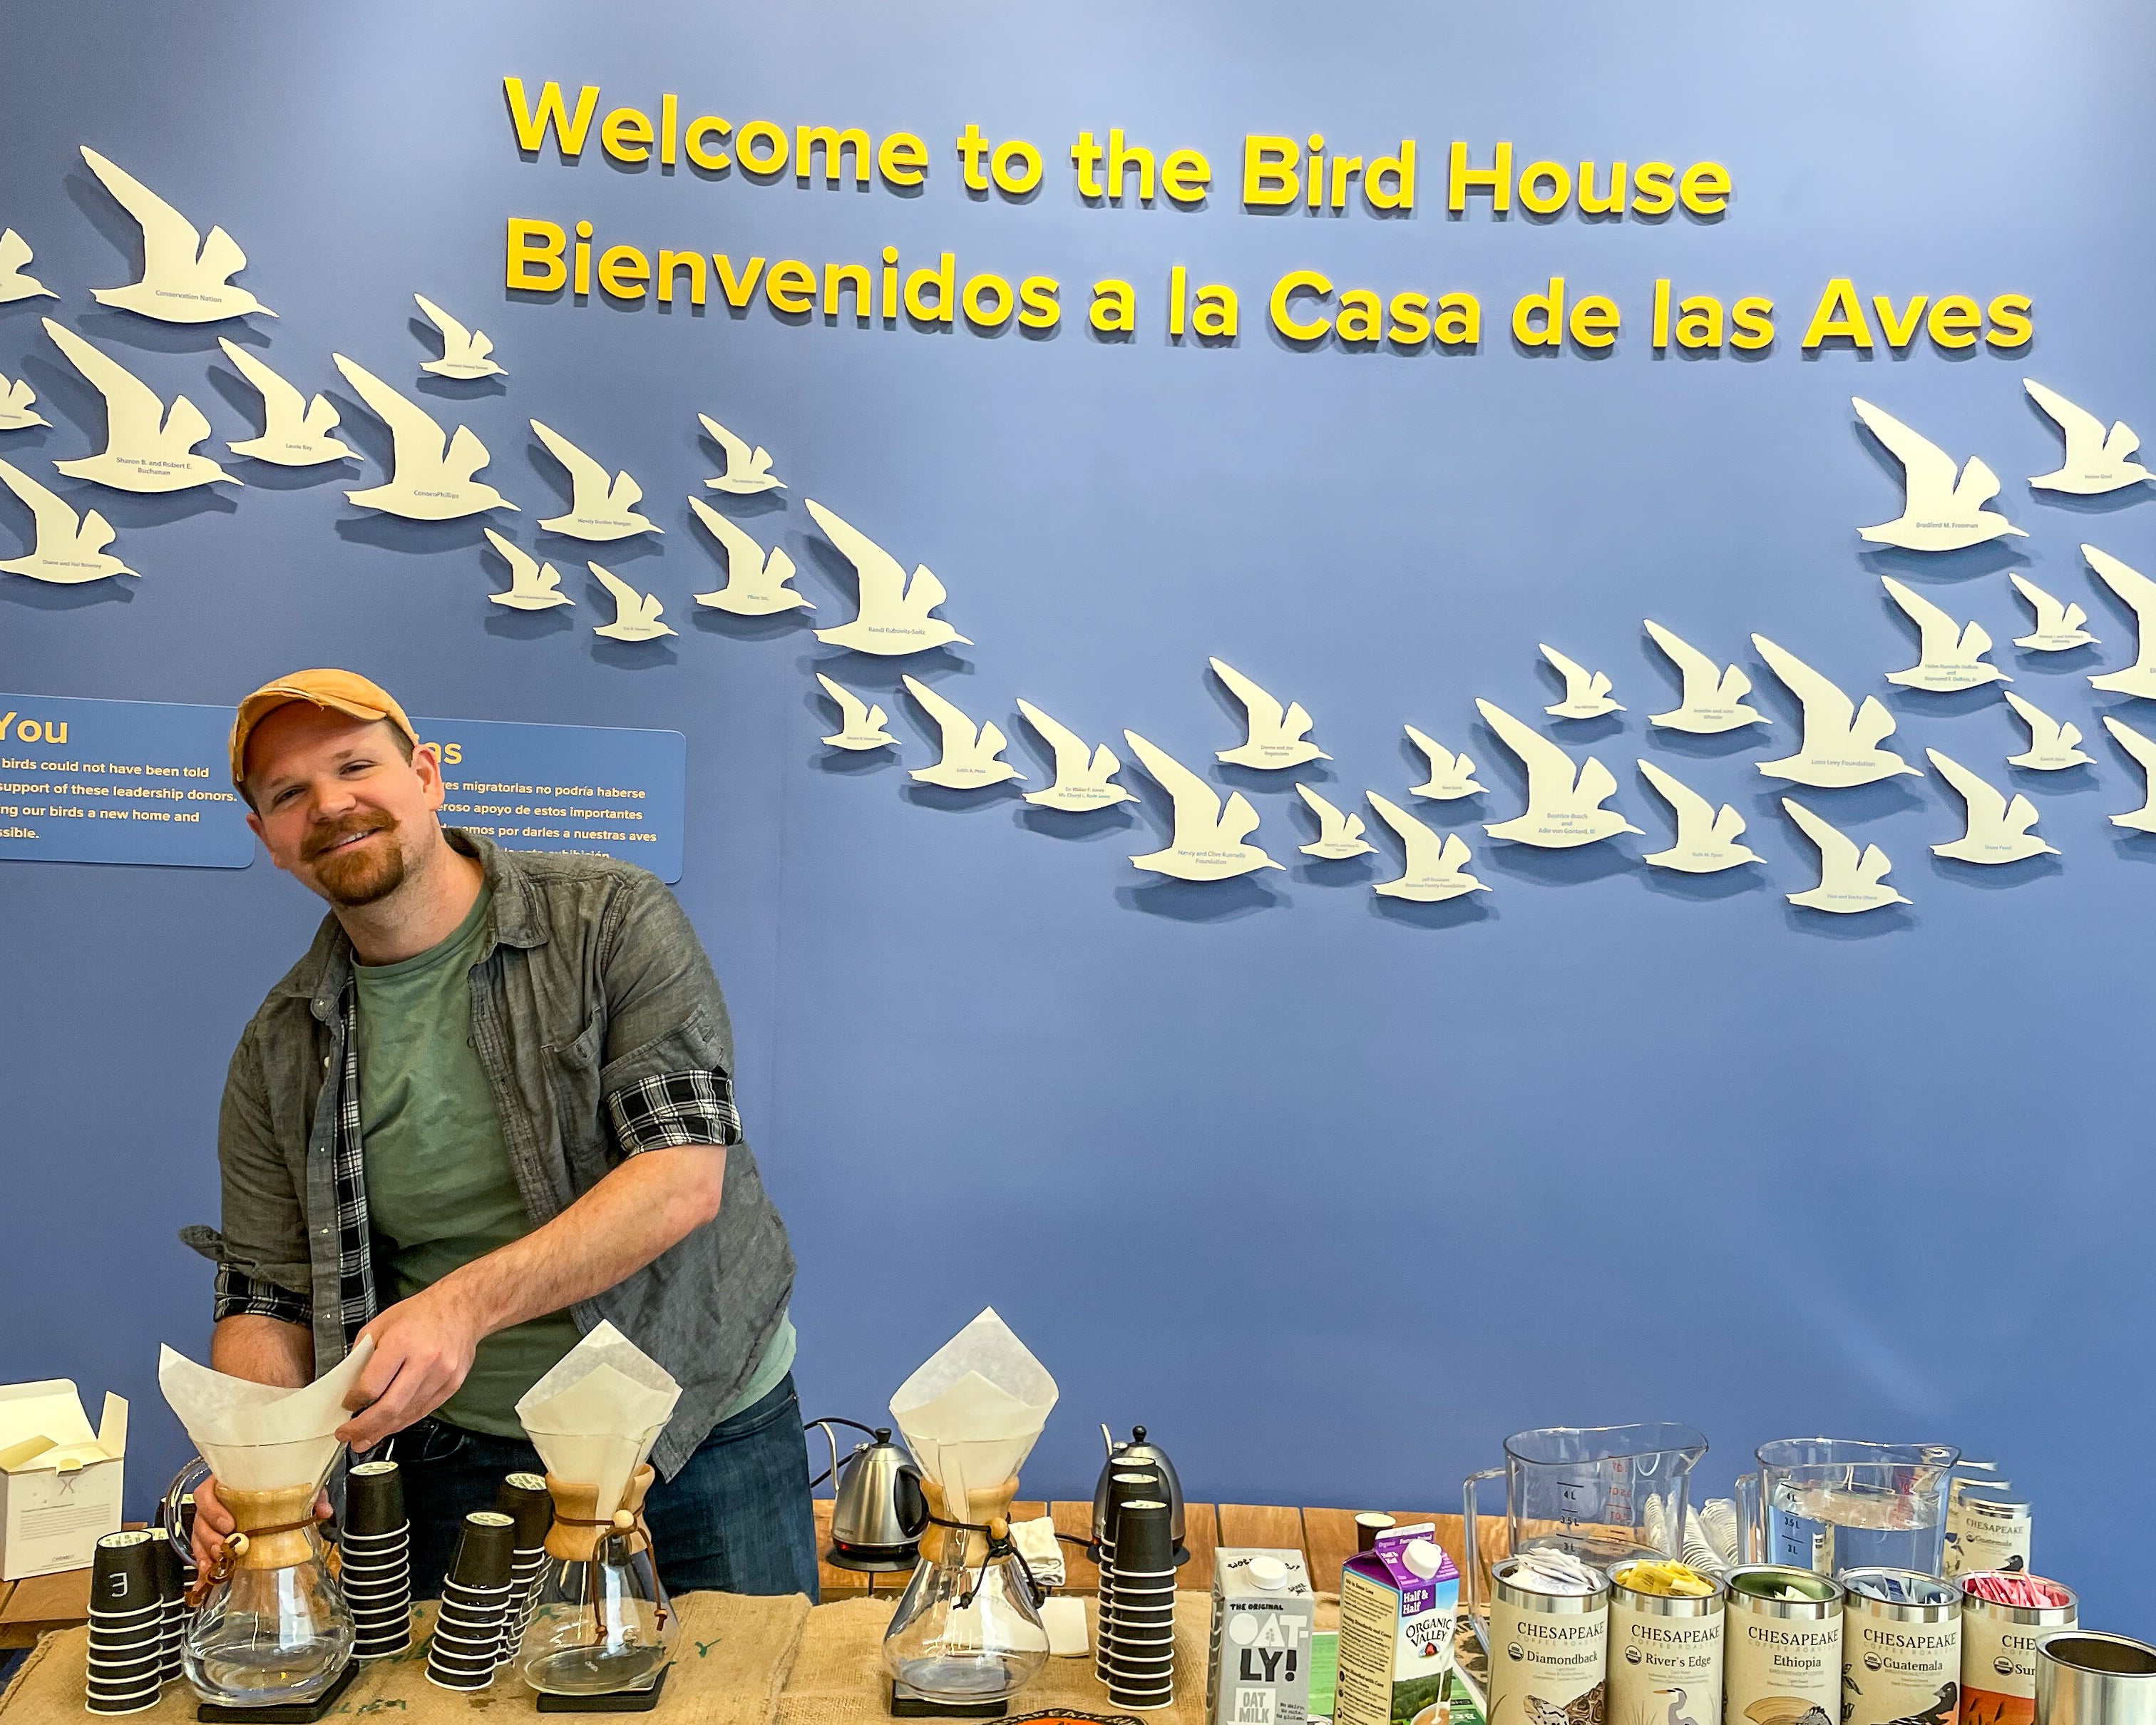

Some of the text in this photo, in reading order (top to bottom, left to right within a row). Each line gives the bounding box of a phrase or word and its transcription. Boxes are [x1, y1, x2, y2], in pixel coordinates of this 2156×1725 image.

[503, 76, 1732, 216] Welcome to the Bird House
[506, 217, 2033, 349] Bienvenidos a la Casa de las Aves
[155, 289, 223, 303] Conservation Nation
[116, 456, 140, 466] Sharon
[163, 461, 185, 470] Robert
[138, 468, 171, 476] Buchanan
[414, 489, 460, 499] ConocoPhillips
[1916, 521, 1943, 530] Bradford
[0, 712, 68, 745] You
[2, 758, 210, 779] birds could not have been told
[1827, 759, 1842, 768] Levy
[1842, 760, 1877, 769] Foundation
[53, 783, 68, 794] of
[71, 784, 110, 797] these
[113, 786, 184, 802] leadership
[187, 788, 238, 802] donors.
[462, 780, 533, 796] migratorias
[535, 784, 552, 794] no
[555, 784, 595, 799] podría
[597, 787, 647, 799] haberse
[22, 806, 200, 824] our birds a new home and
[473, 804, 513, 817] apoyo
[514, 804, 531, 815] de
[533, 806, 568, 818] estos
[570, 806, 645, 821] importantes
[498, 826, 520, 839] por
[521, 826, 560, 839] darles
[563, 829, 571, 839] a
[573, 829, 626, 841] nuestras
[628, 833, 658, 843] aves
[1178, 849, 1196, 859] Nancy
[1564, 1490, 1576, 1500] 4 L
[1966, 1517, 2024, 1535] CHESAPEAKE
[1564, 1542, 1576, 1552] 3 L
[1403, 1590, 1429, 1603] Half &
[1403, 1601, 1422, 1614] Half
[1406, 1618, 1452, 1639] ORGANIC
[1516, 1620, 1605, 1640] CHESAPEAKE
[1631, 1624, 1722, 1644] CHESAPEAKE
[1747, 1626, 1840, 1646] CHESAPEAKE
[1410, 1630, 1448, 1647] VALLEY
[1863, 1628, 1958, 1649] CHESAPEAKE
[1239, 1647, 1297, 1682] LY!
[1526, 1650, 1598, 1666] Diamondback
[1645, 1652, 1712, 1668] River's Edge
[1773, 1654, 1822, 1670] Ethiopia
[1883, 1657, 1944, 1672] Guatemala
[1243, 1691, 1267, 1707] OAT
[1238, 1707, 1270, 1724] MILK
